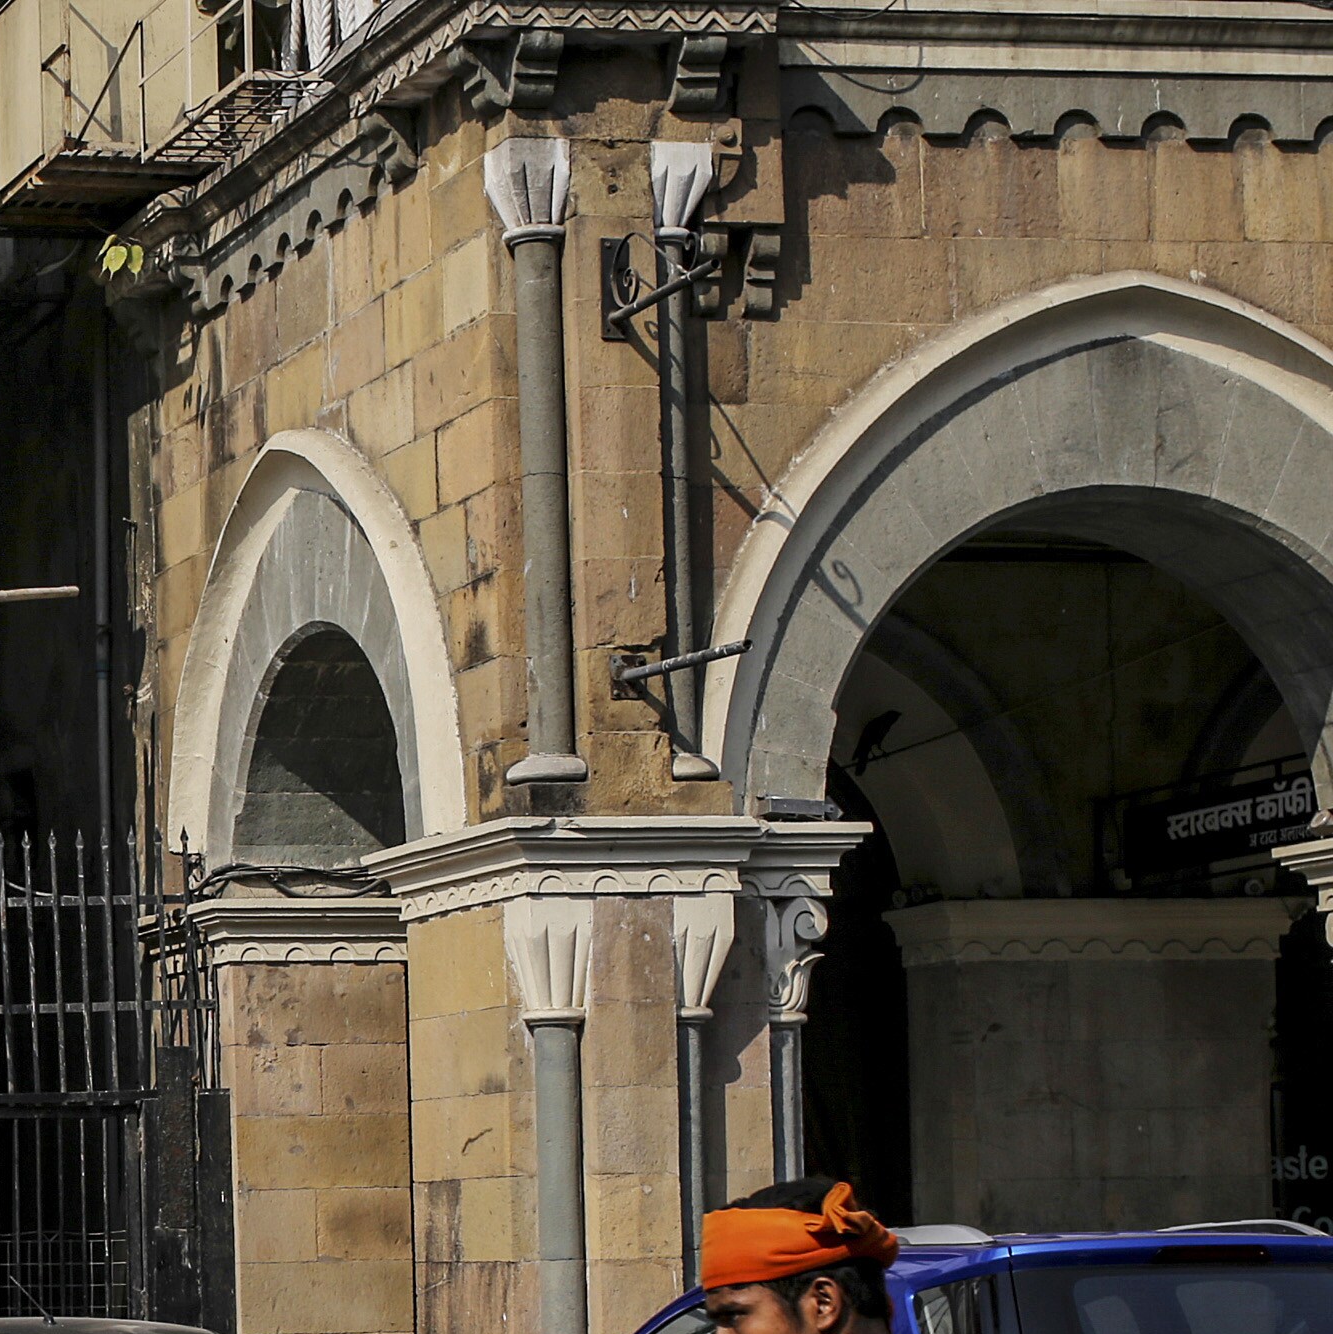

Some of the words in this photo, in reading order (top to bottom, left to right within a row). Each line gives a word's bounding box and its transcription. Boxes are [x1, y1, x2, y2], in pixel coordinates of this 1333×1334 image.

[1166, 798, 1254, 841] स्टारबक्स
[1255, 776, 1314, 822] कॉफी
[1271, 1145, 1329, 1180] aste
